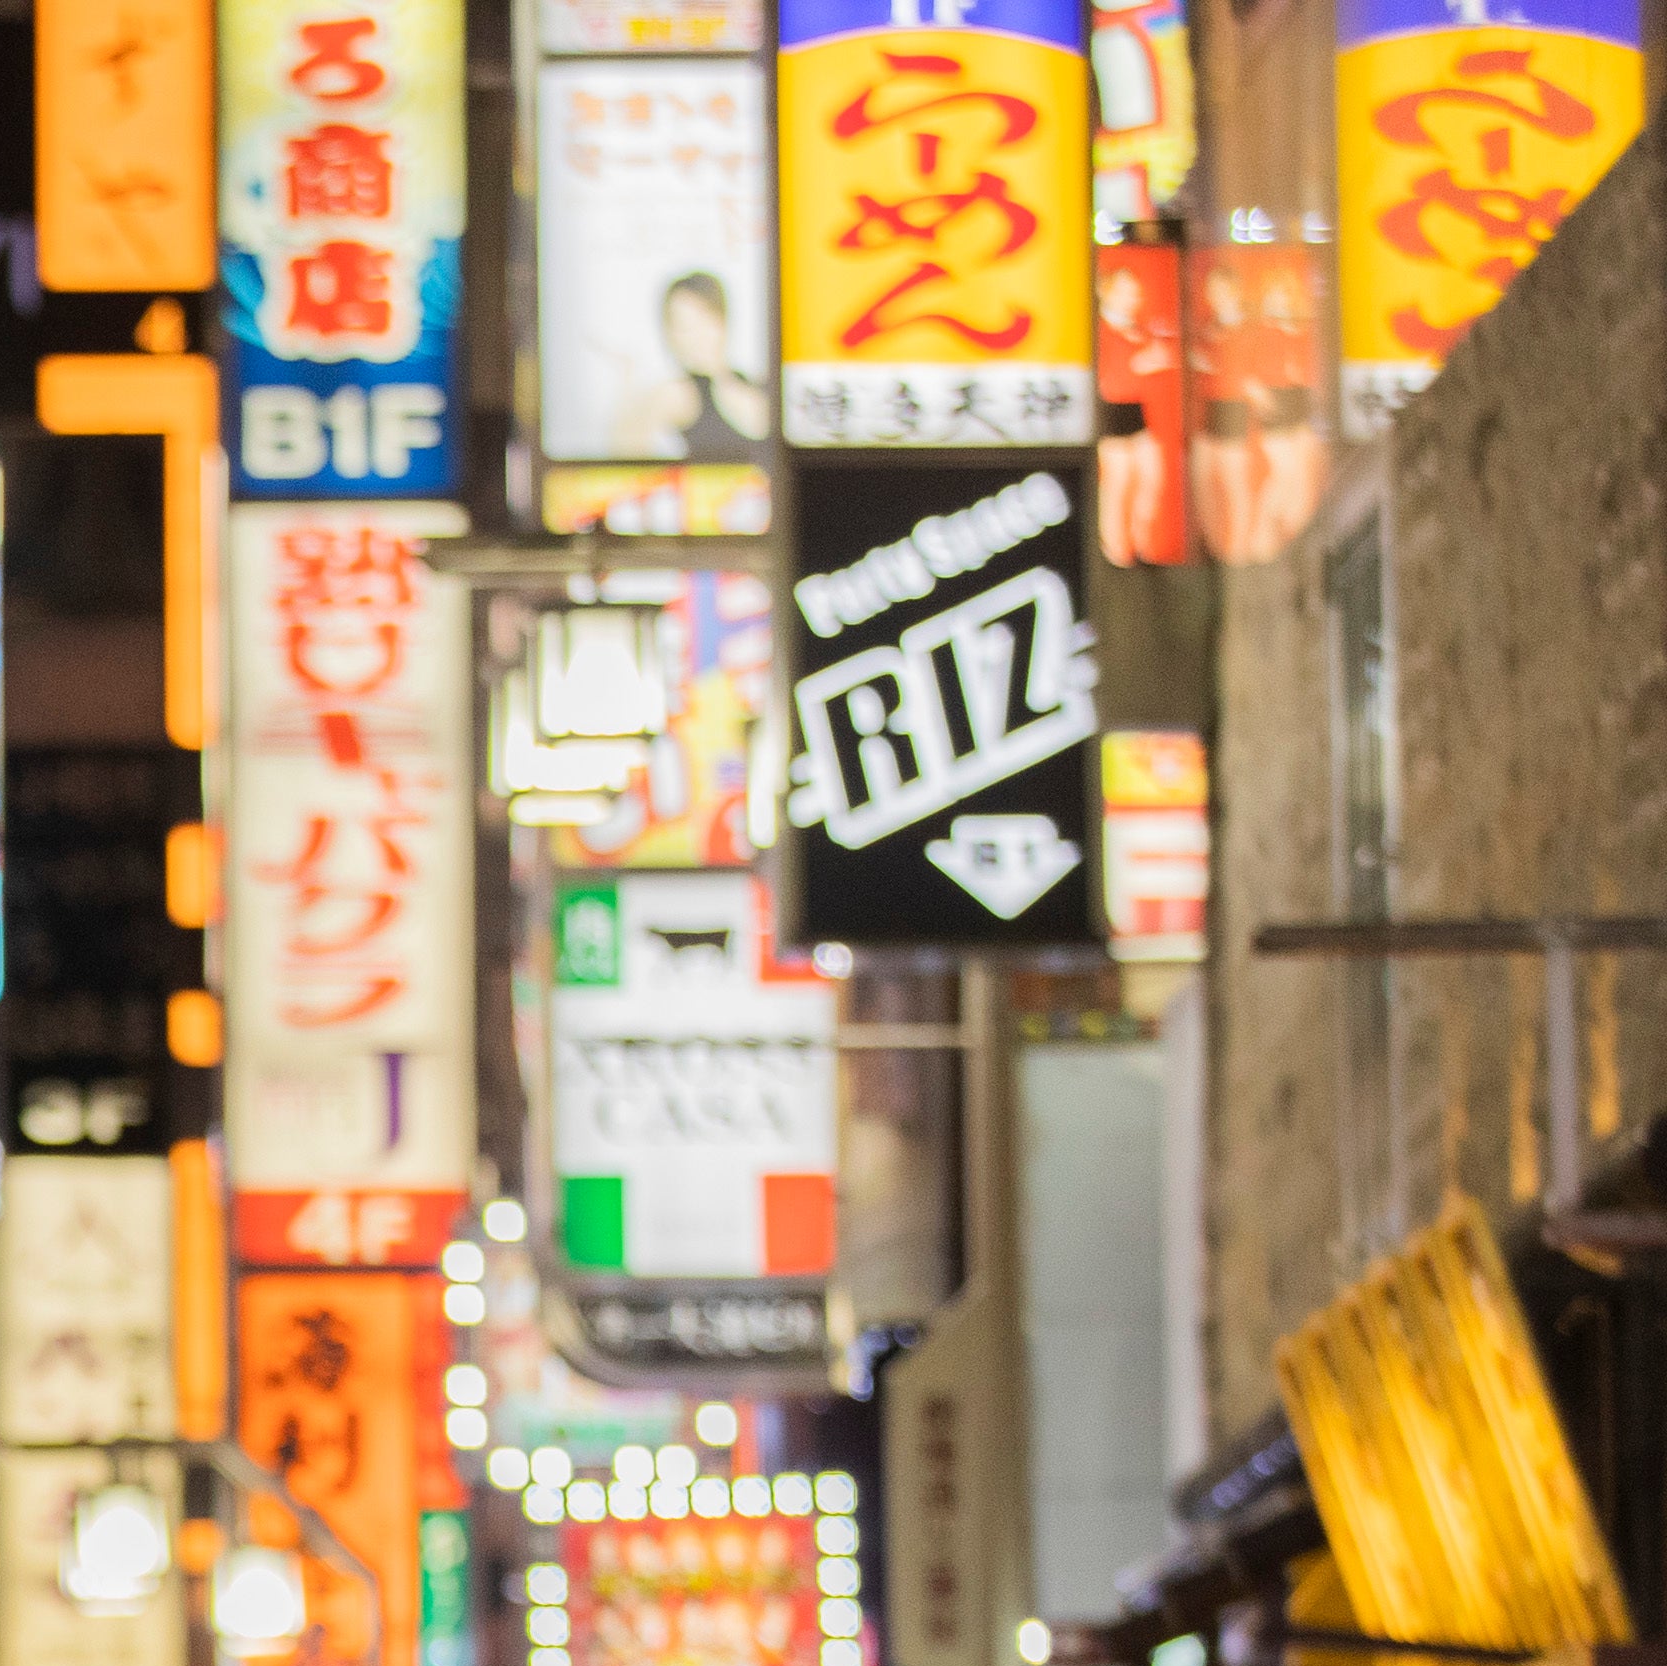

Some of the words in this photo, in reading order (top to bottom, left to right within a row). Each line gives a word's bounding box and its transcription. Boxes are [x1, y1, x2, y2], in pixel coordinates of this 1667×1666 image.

[831, 50, 1041, 352] らーめん
[239, 385, 445, 480] B1F
[822, 596, 1067, 814] RIZ
[285, 1195, 413, 1264] 4F
